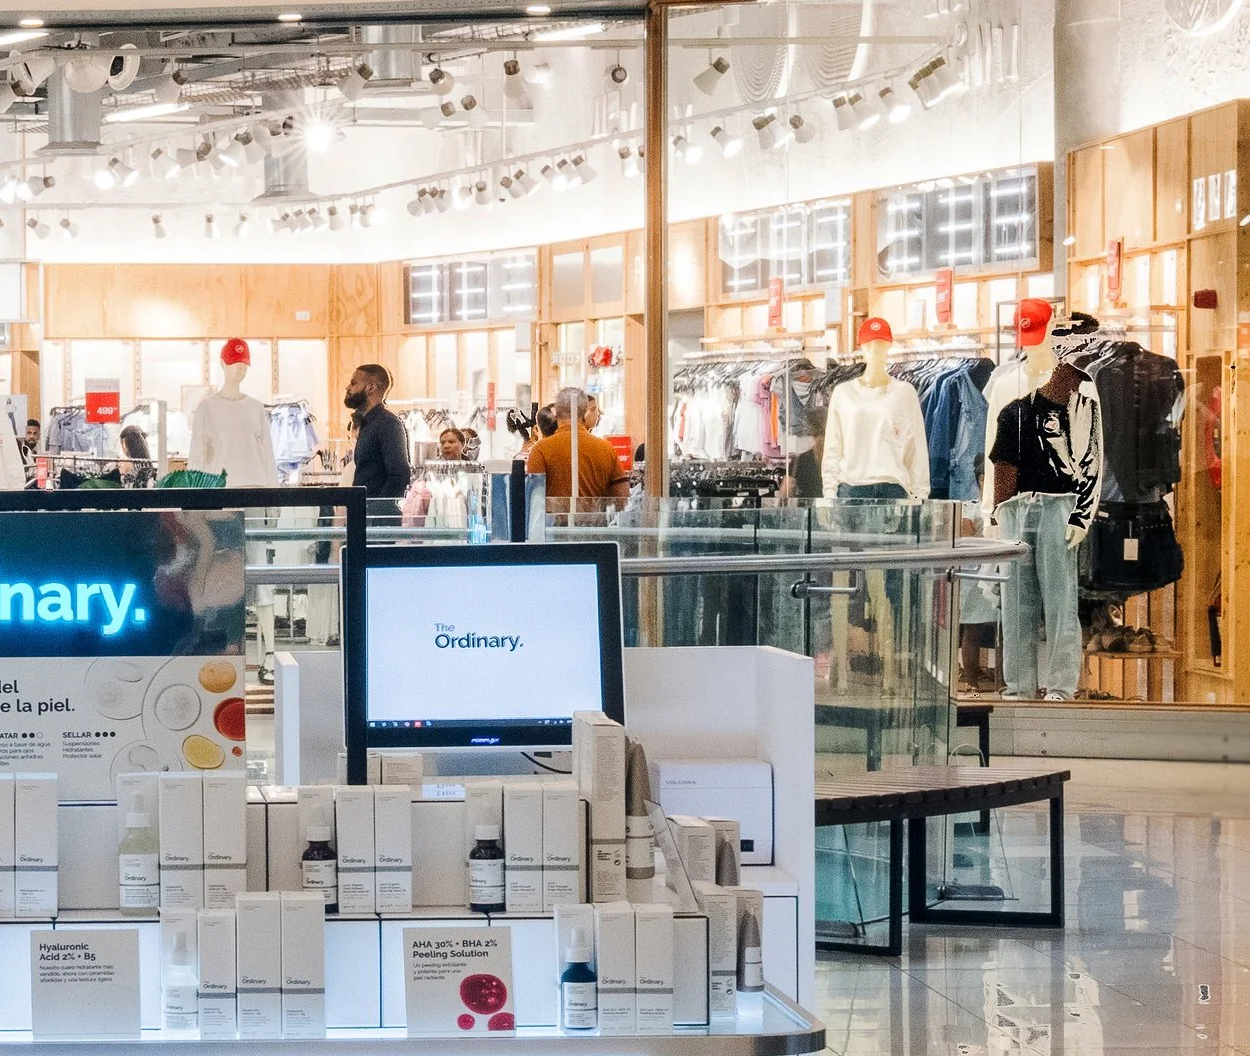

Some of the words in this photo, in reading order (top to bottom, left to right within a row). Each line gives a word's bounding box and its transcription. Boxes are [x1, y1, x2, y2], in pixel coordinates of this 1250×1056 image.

[434, 623, 455, 632] The
[434, 632, 524, 652] Ordinary.
[16, 699, 32, 713] la
[38, 698, 75, 716] piel.
[62, 731, 92, 739] SELLAR
[39, 943, 89, 953] Hyaluronic
[412, 940, 433, 949] AHA
[435, 940, 453, 949] 30%
[462, 939, 482, 948] BHA
[485, 939, 498, 947] 2%
[39, 953, 60, 961] Acid
[62, 953, 75, 961] 2%
[84, 952, 96, 961] B5
[413, 950, 448, 960] Peeling
[450, 949, 489, 958] Solution
